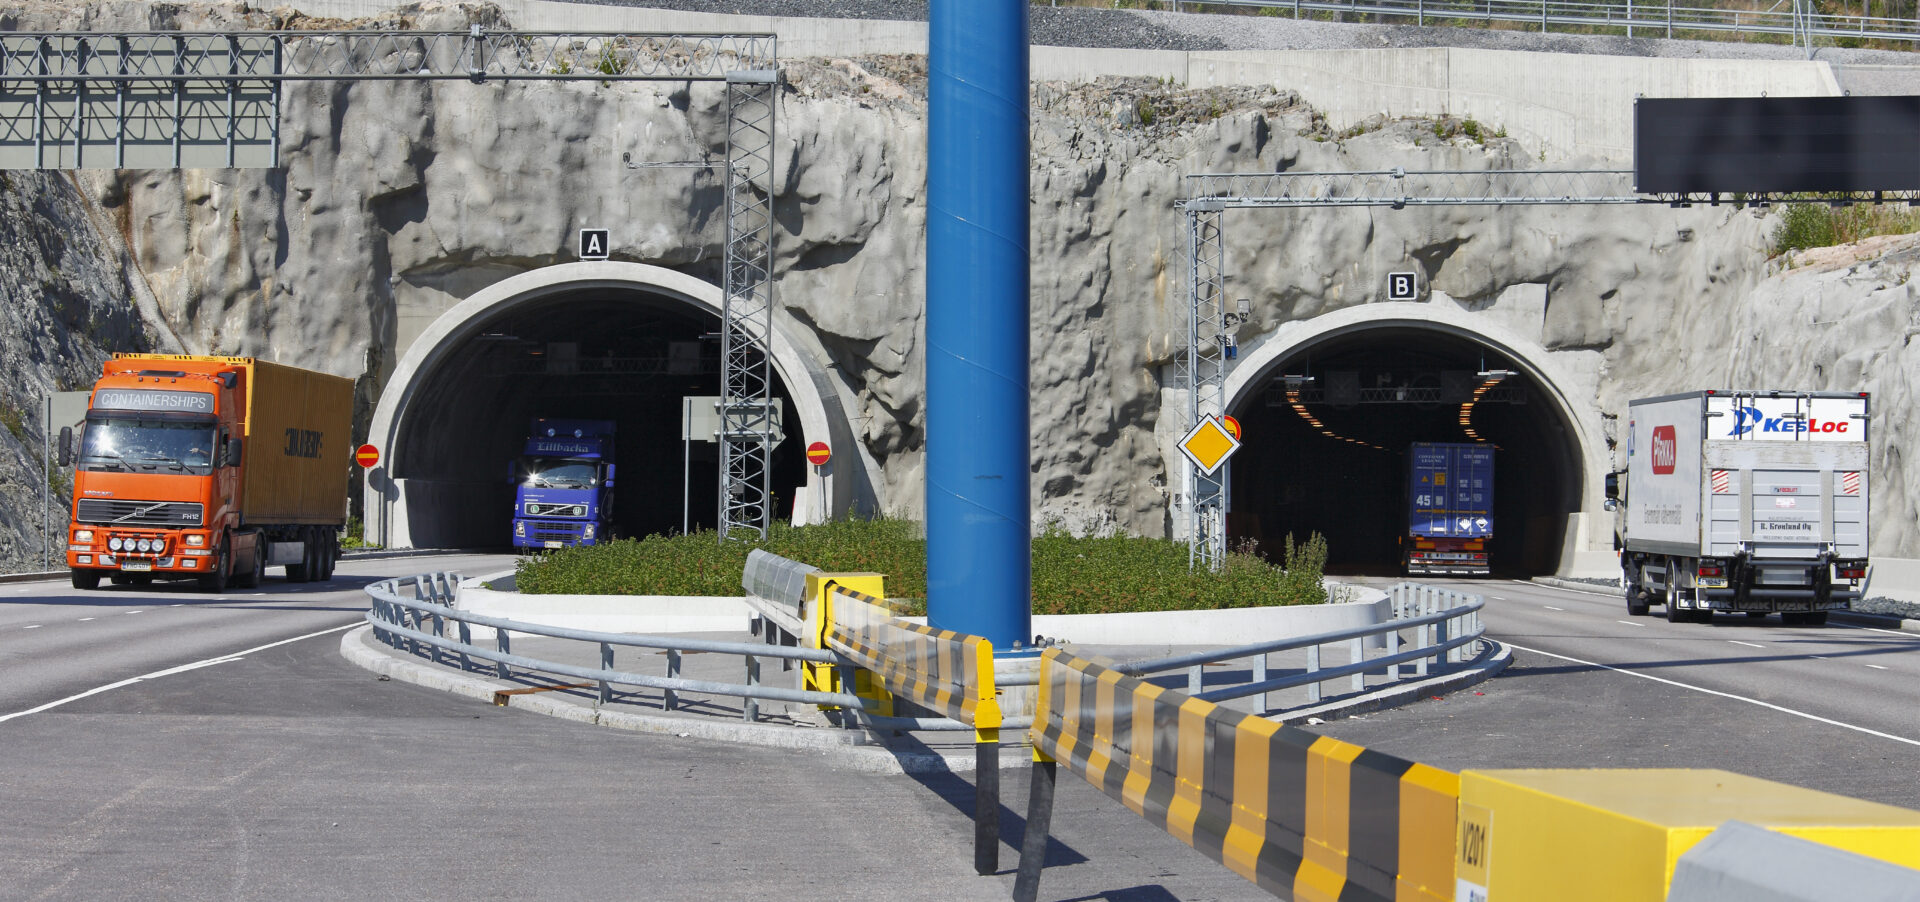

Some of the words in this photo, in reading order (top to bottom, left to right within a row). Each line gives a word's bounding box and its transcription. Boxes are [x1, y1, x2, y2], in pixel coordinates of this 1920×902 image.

[587, 233, 602, 254] A
[1395, 276, 1409, 296] B
[101, 392, 207, 409] CONTAINERSHIPS
[536, 442, 589, 453] Lillbacka
[1416, 494, 1431, 507] 45
[1699, 599, 1733, 608] VAK
[1815, 601, 1848, 610] VAK
[1461, 820, 1486, 868] V201
